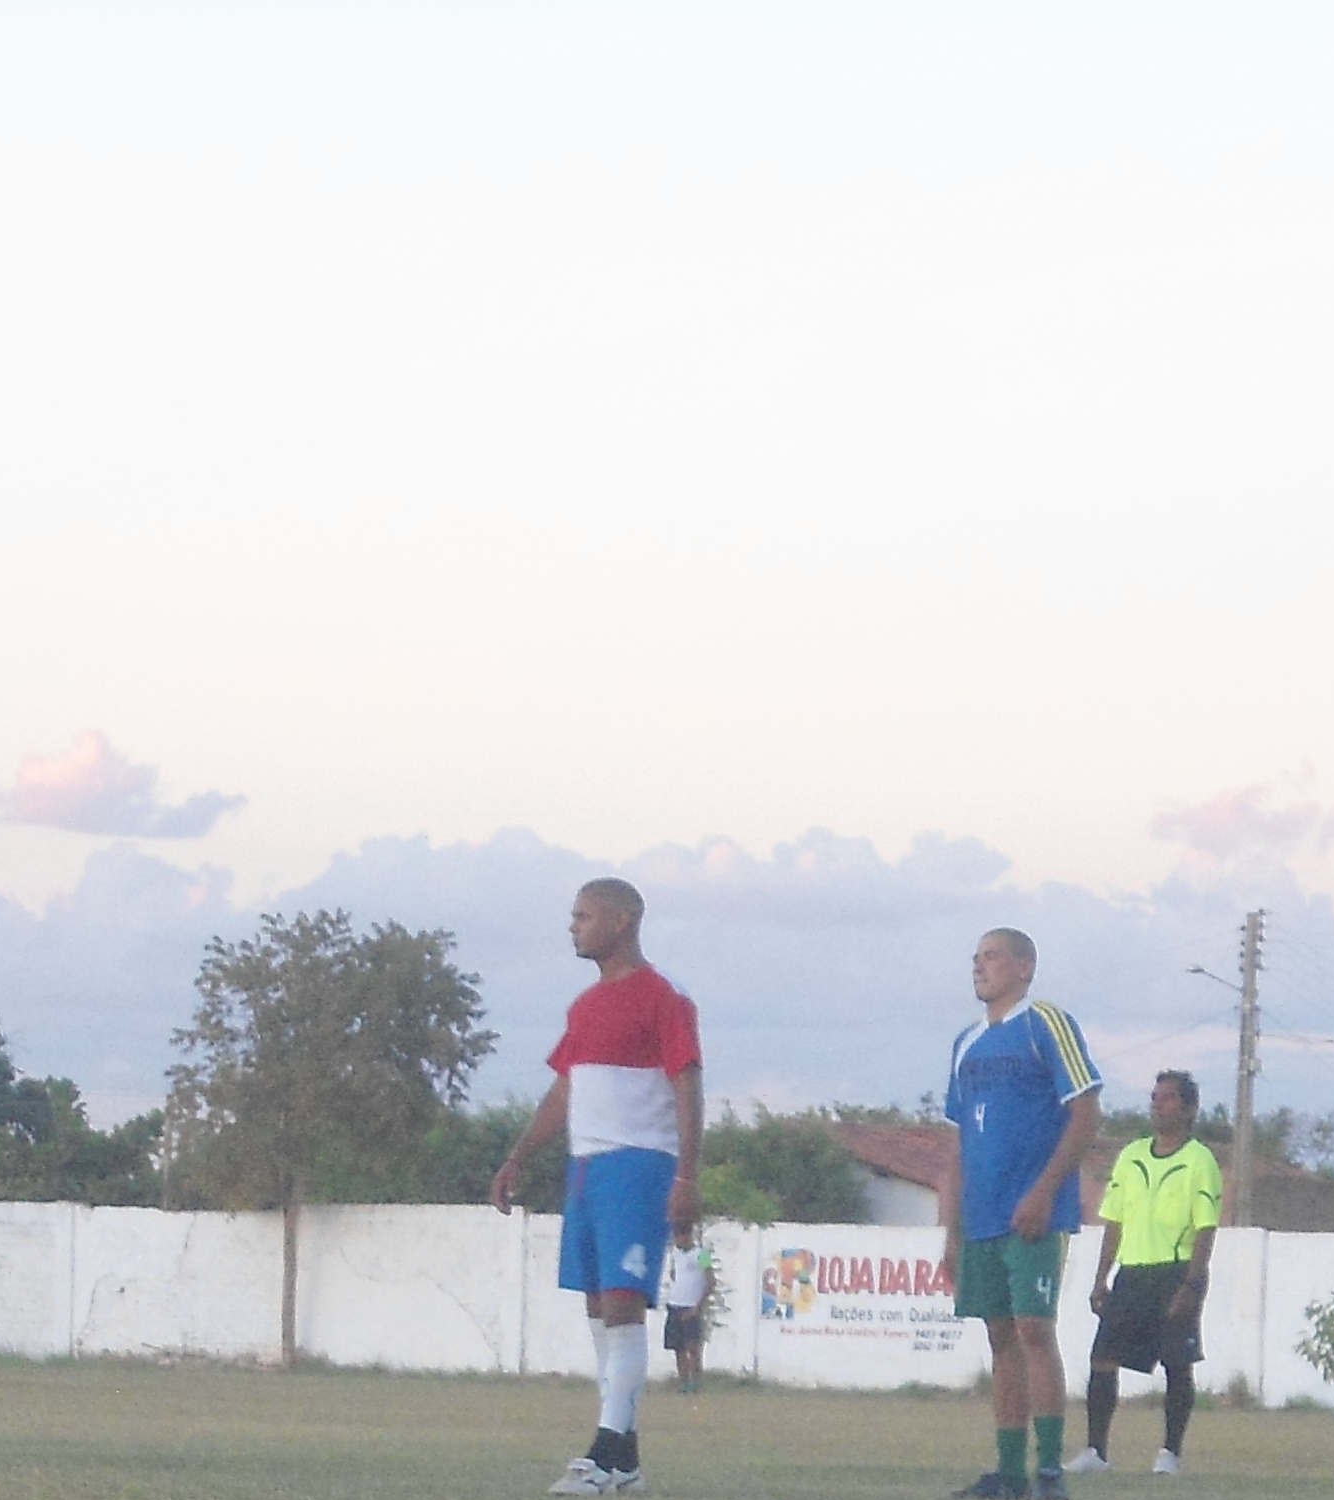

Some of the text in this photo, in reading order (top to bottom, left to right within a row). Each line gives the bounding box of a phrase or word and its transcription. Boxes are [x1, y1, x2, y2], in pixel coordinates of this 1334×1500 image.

[975, 1103, 985, 1132] 4
[817, 1256, 954, 1297] LOJA DA RA
[1037, 1276, 1052, 1305] 4
